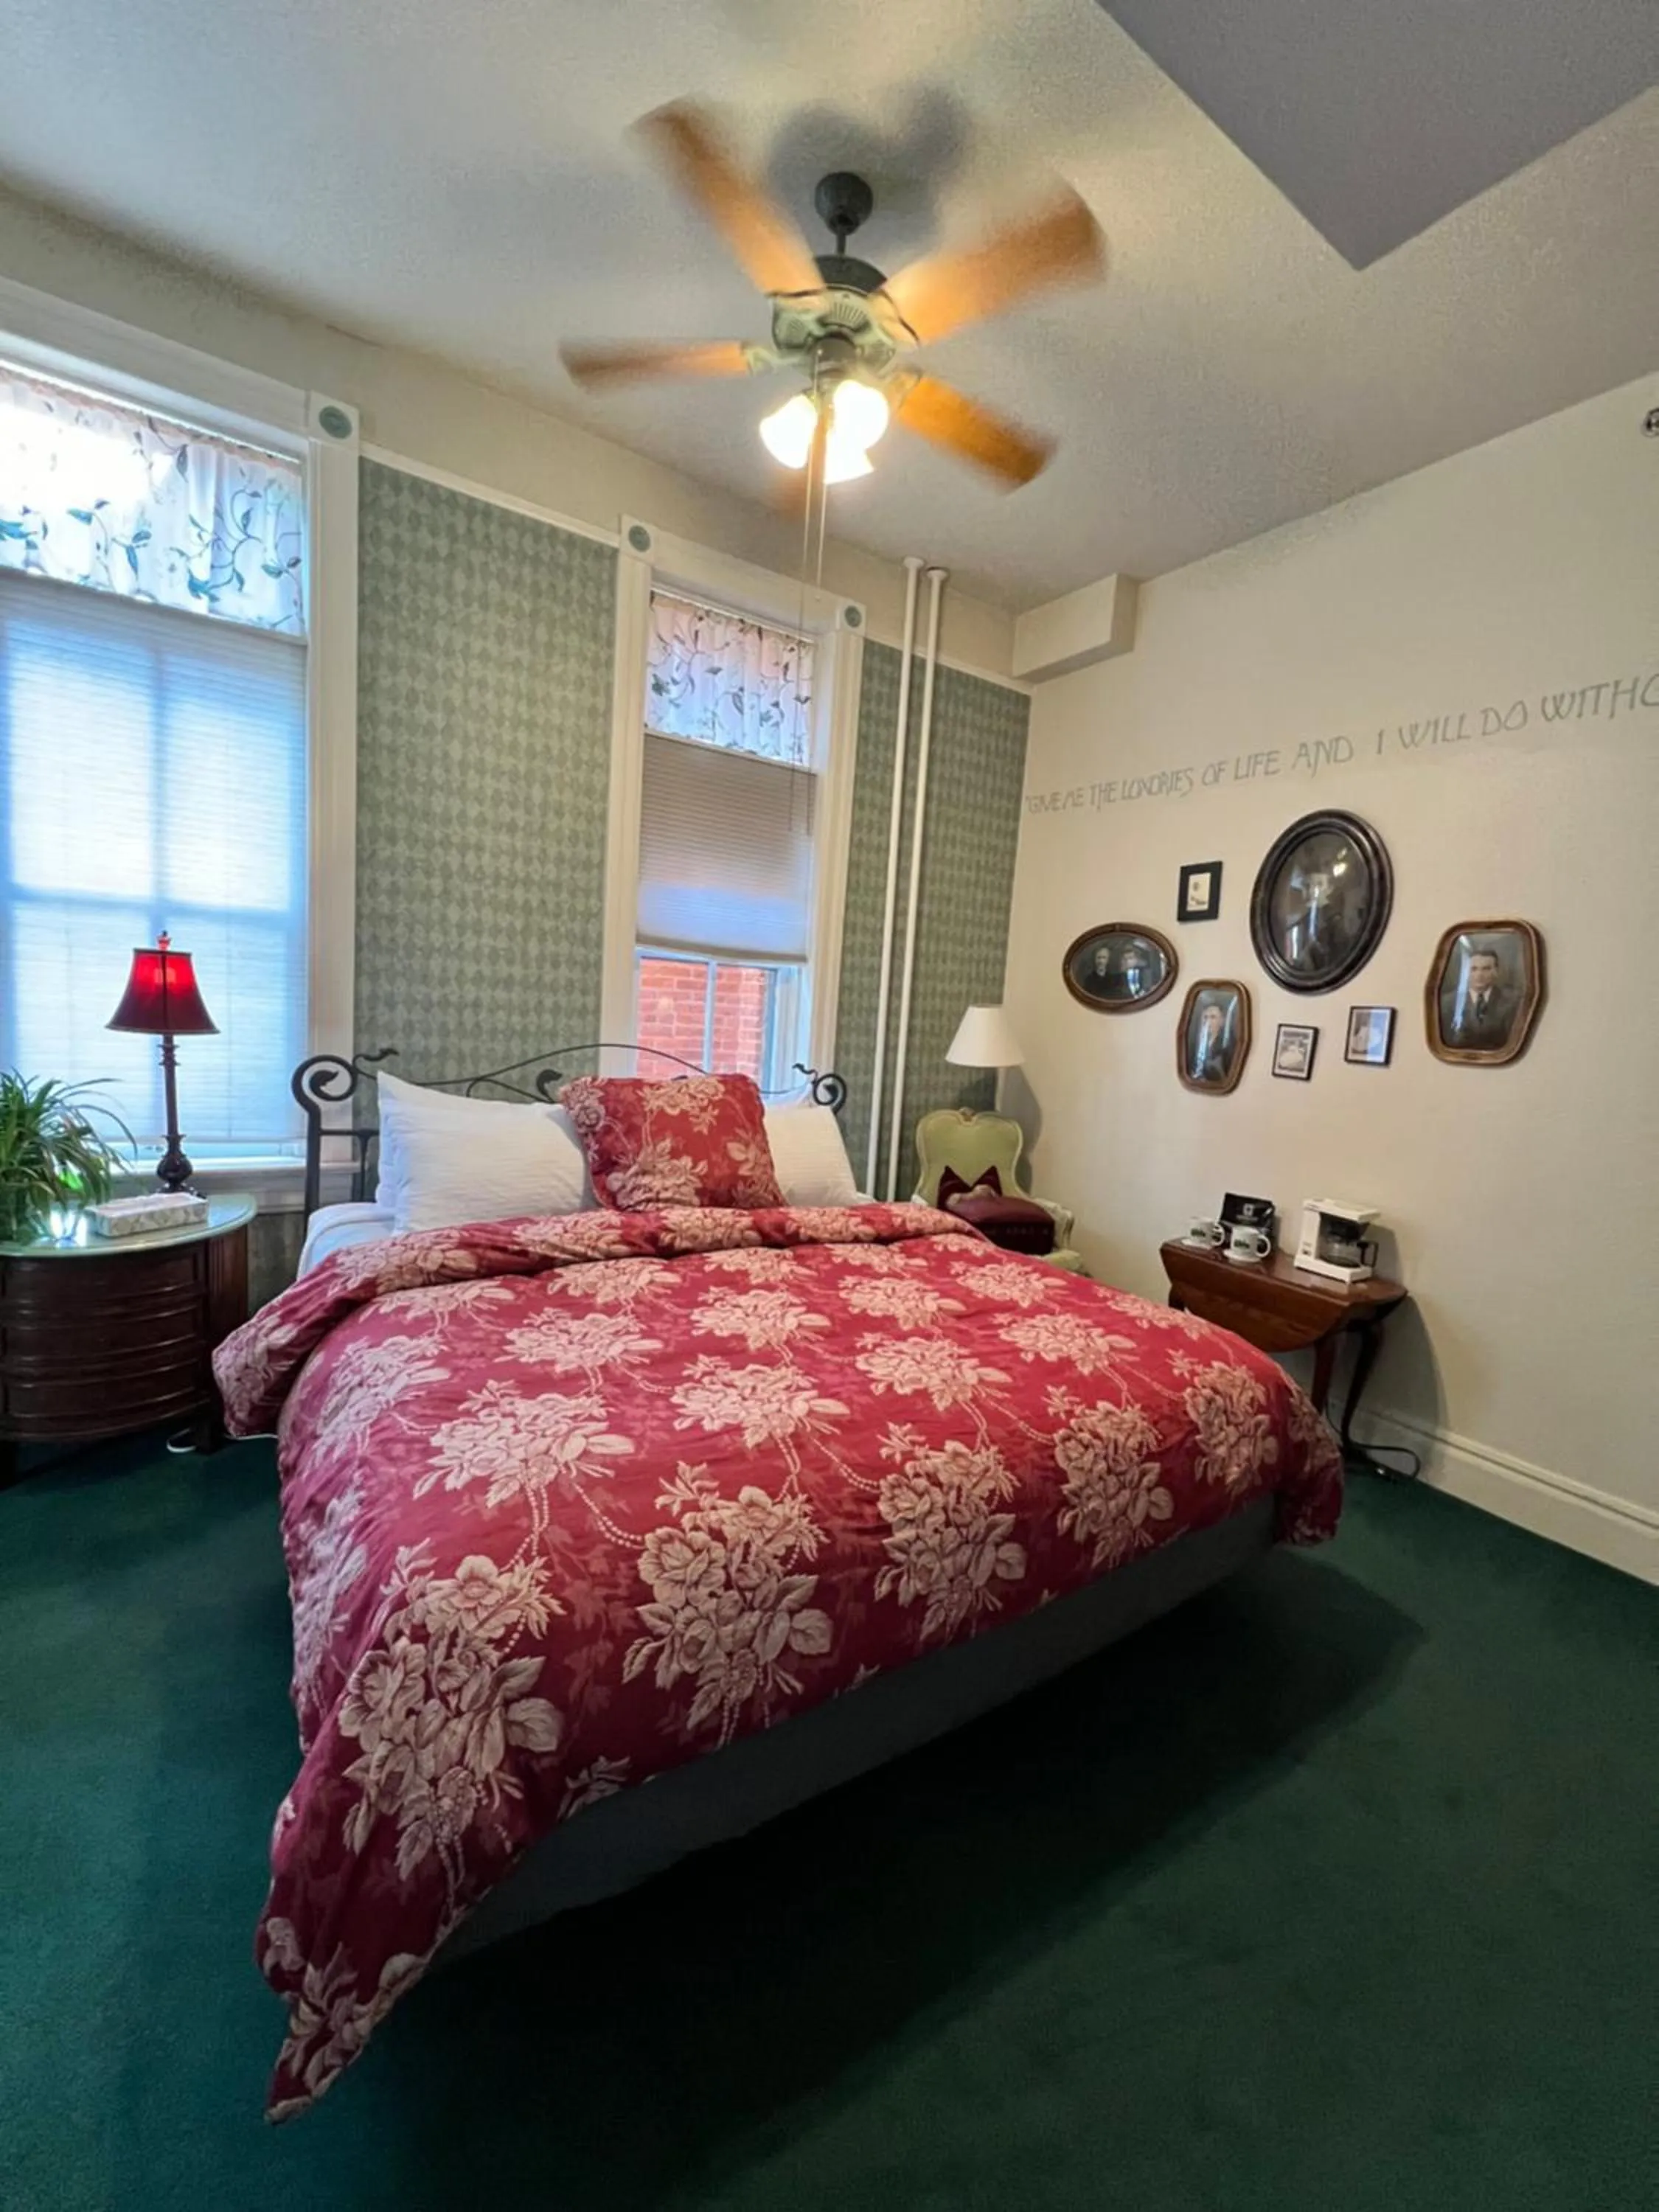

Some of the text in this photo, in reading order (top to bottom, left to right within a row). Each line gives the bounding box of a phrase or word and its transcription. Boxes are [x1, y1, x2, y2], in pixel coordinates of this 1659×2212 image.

[1089, 782, 1118, 813] THE
[1202, 759, 1229, 787] OF
[1234, 749, 1281, 782] LIFE
[1291, 735, 1354, 779] AND
[1375, 728, 1385, 755] I
[1398, 712, 1472, 750] WILL
[1479, 699, 1528, 737] DO
